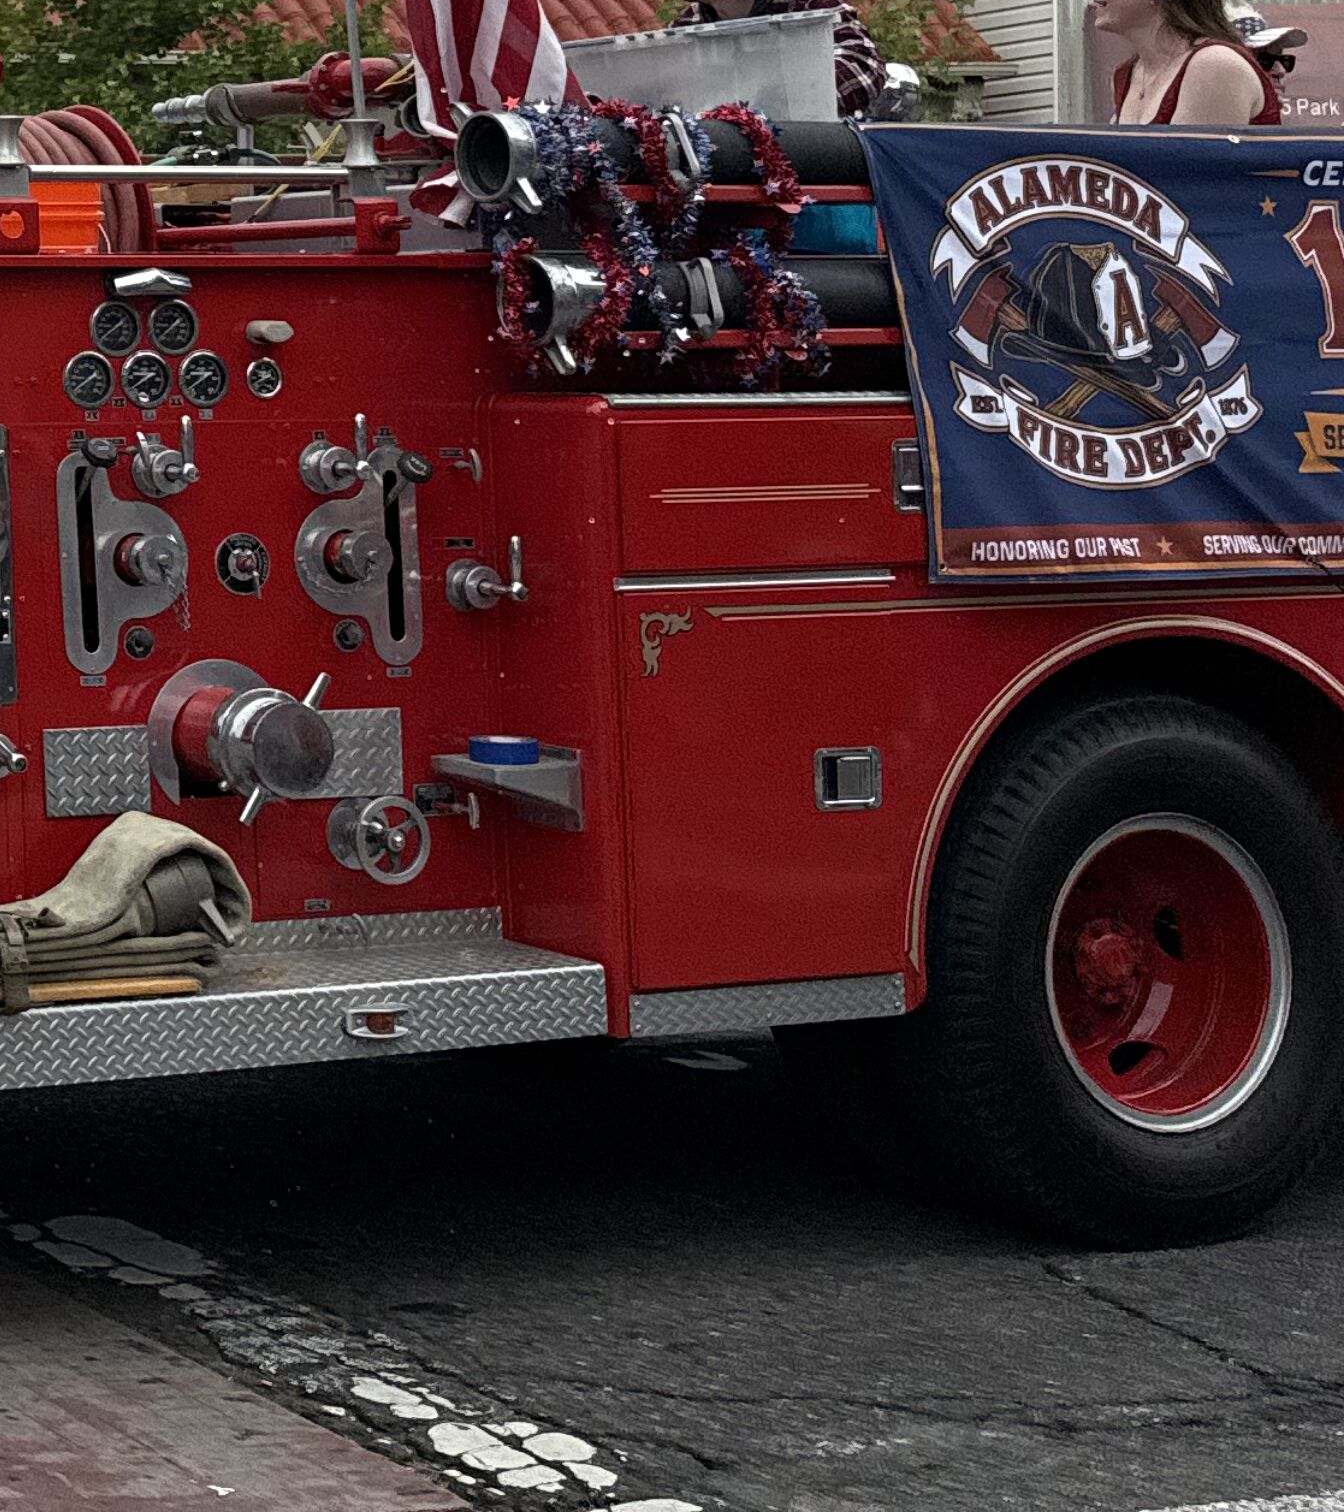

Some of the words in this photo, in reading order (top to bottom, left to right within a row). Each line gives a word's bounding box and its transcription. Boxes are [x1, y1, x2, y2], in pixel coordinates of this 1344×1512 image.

[1296, 97, 1340, 116] Park
[1303, 160, 1344, 187] CE
[968, 164, 1163, 244] ALAMEDA
[1109, 268, 1146, 349] A
[1016, 406, 1109, 477] FIRE
[1117, 411, 1216, 478] DEPT.
[971, 539, 1069, 561] HONORING
[1075, 537, 1108, 558] OUR
[1203, 535, 1262, 555] SERVING
[1262, 536, 1296, 554] OUR
